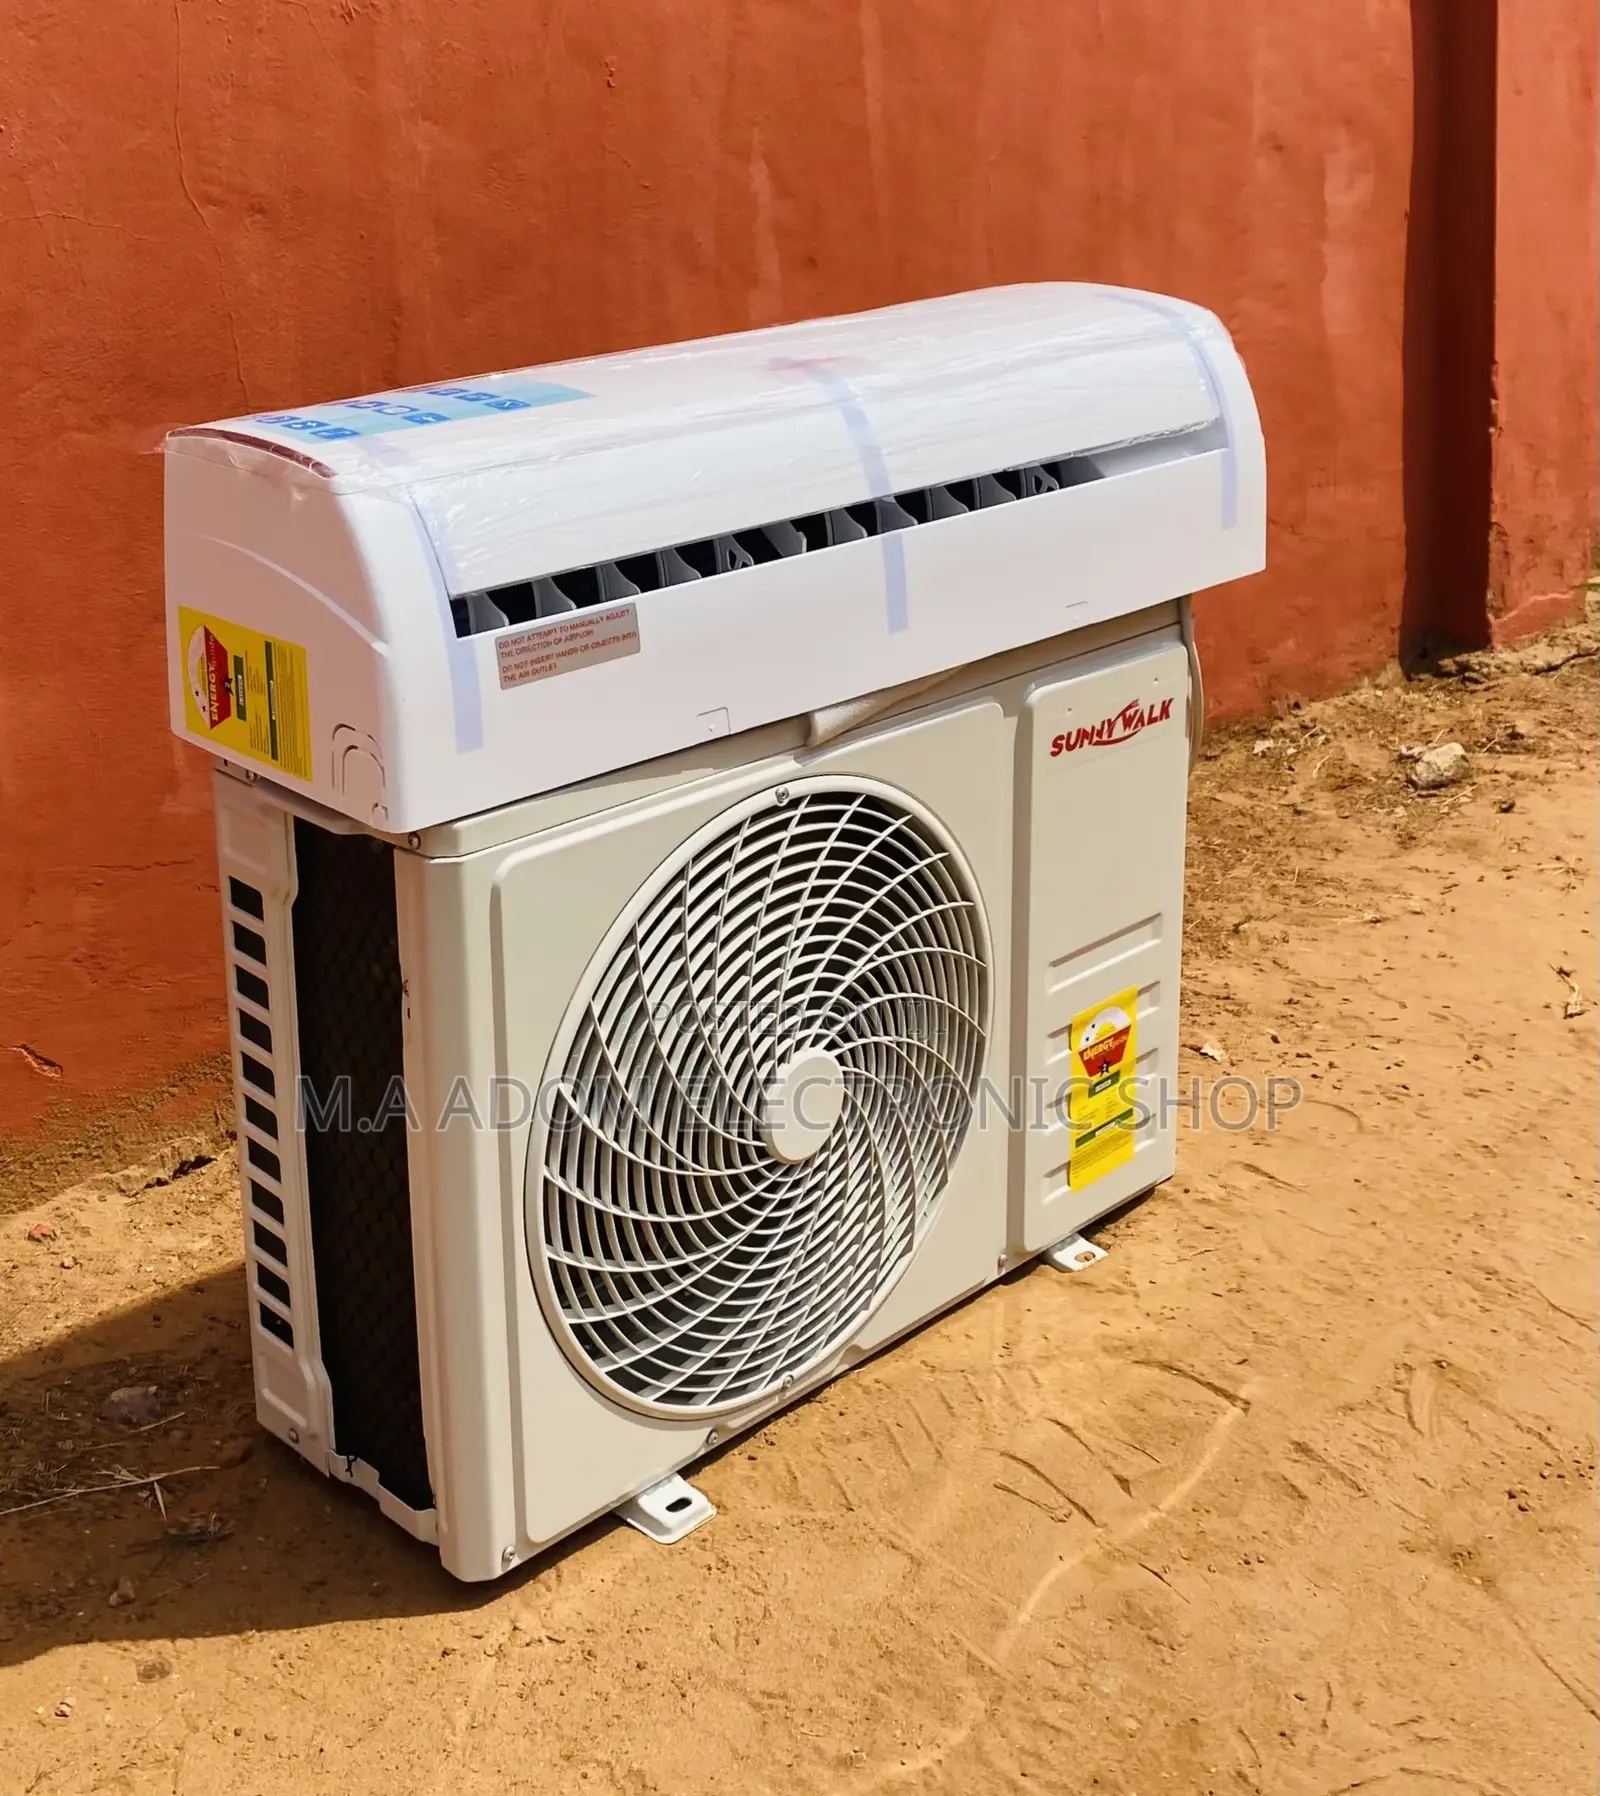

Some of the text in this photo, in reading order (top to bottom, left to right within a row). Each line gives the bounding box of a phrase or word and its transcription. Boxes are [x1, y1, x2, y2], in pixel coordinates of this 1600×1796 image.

[499, 609, 630, 649] DO NOT ATTEMPT TO MANUALLY ADJUST
[500, 628, 594, 659] THE DIRECTION OF AIRFLOW
[502, 630, 637, 673] DO NOT INSERT HANDS OR OBJECTS INTO
[503, 663, 557, 683] THE AIR OUTLET
